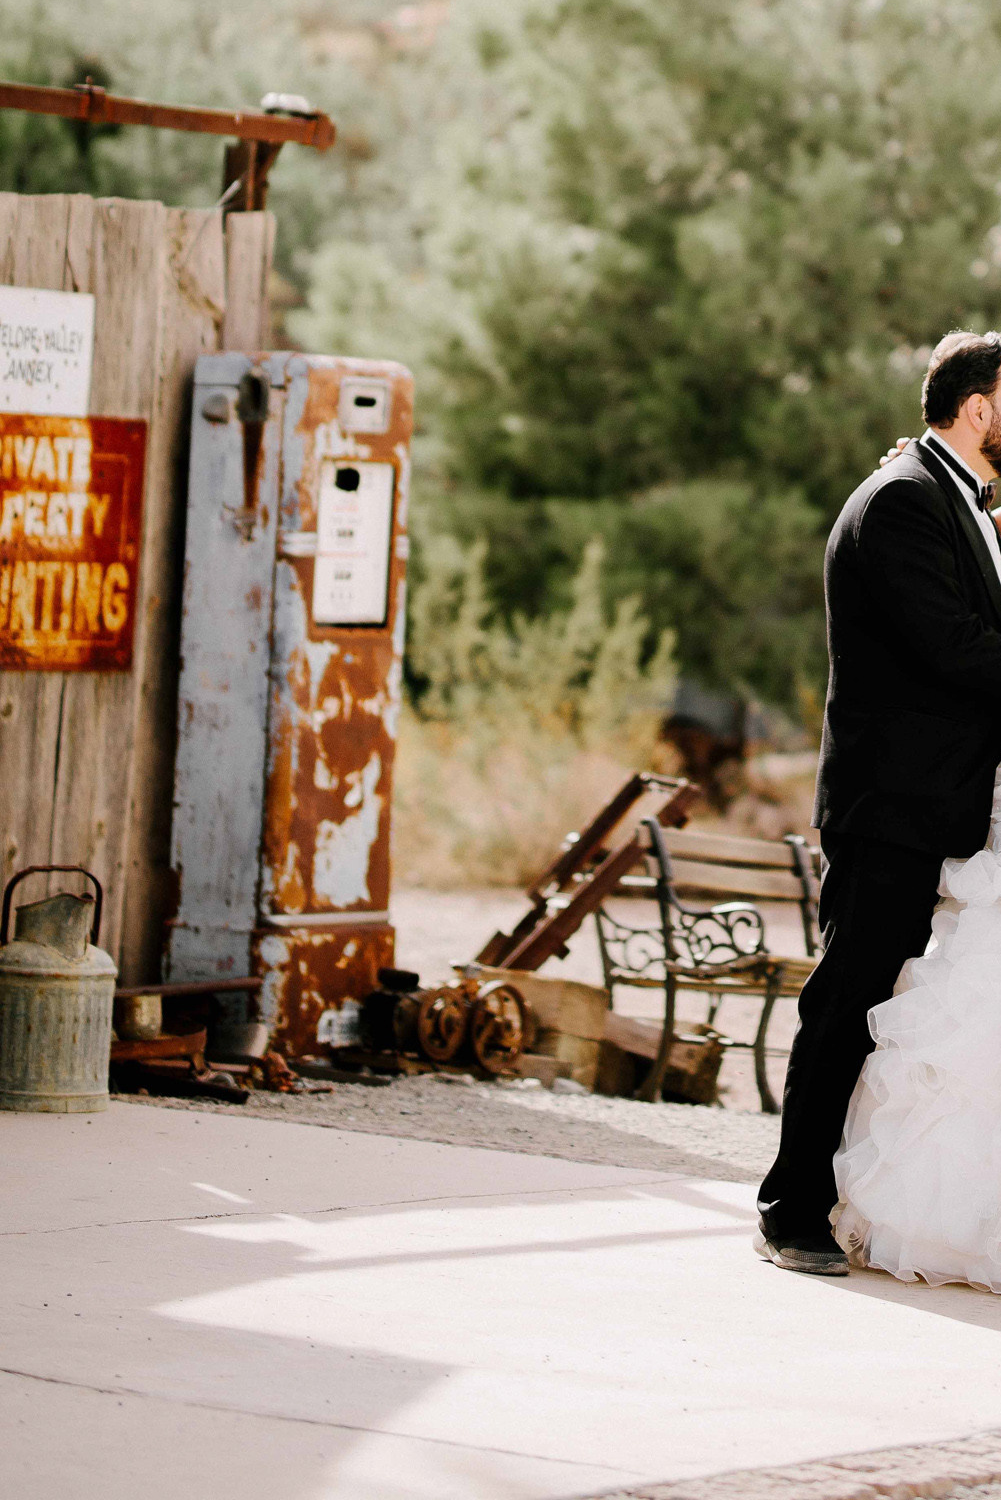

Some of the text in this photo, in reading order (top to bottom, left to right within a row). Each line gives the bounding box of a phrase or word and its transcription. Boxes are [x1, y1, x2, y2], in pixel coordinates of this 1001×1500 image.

[0, 323, 83, 353] ELOPE VALLEY
[6, 359, 54, 383] ANNEX
[0, 435, 91, 482] IVATE
